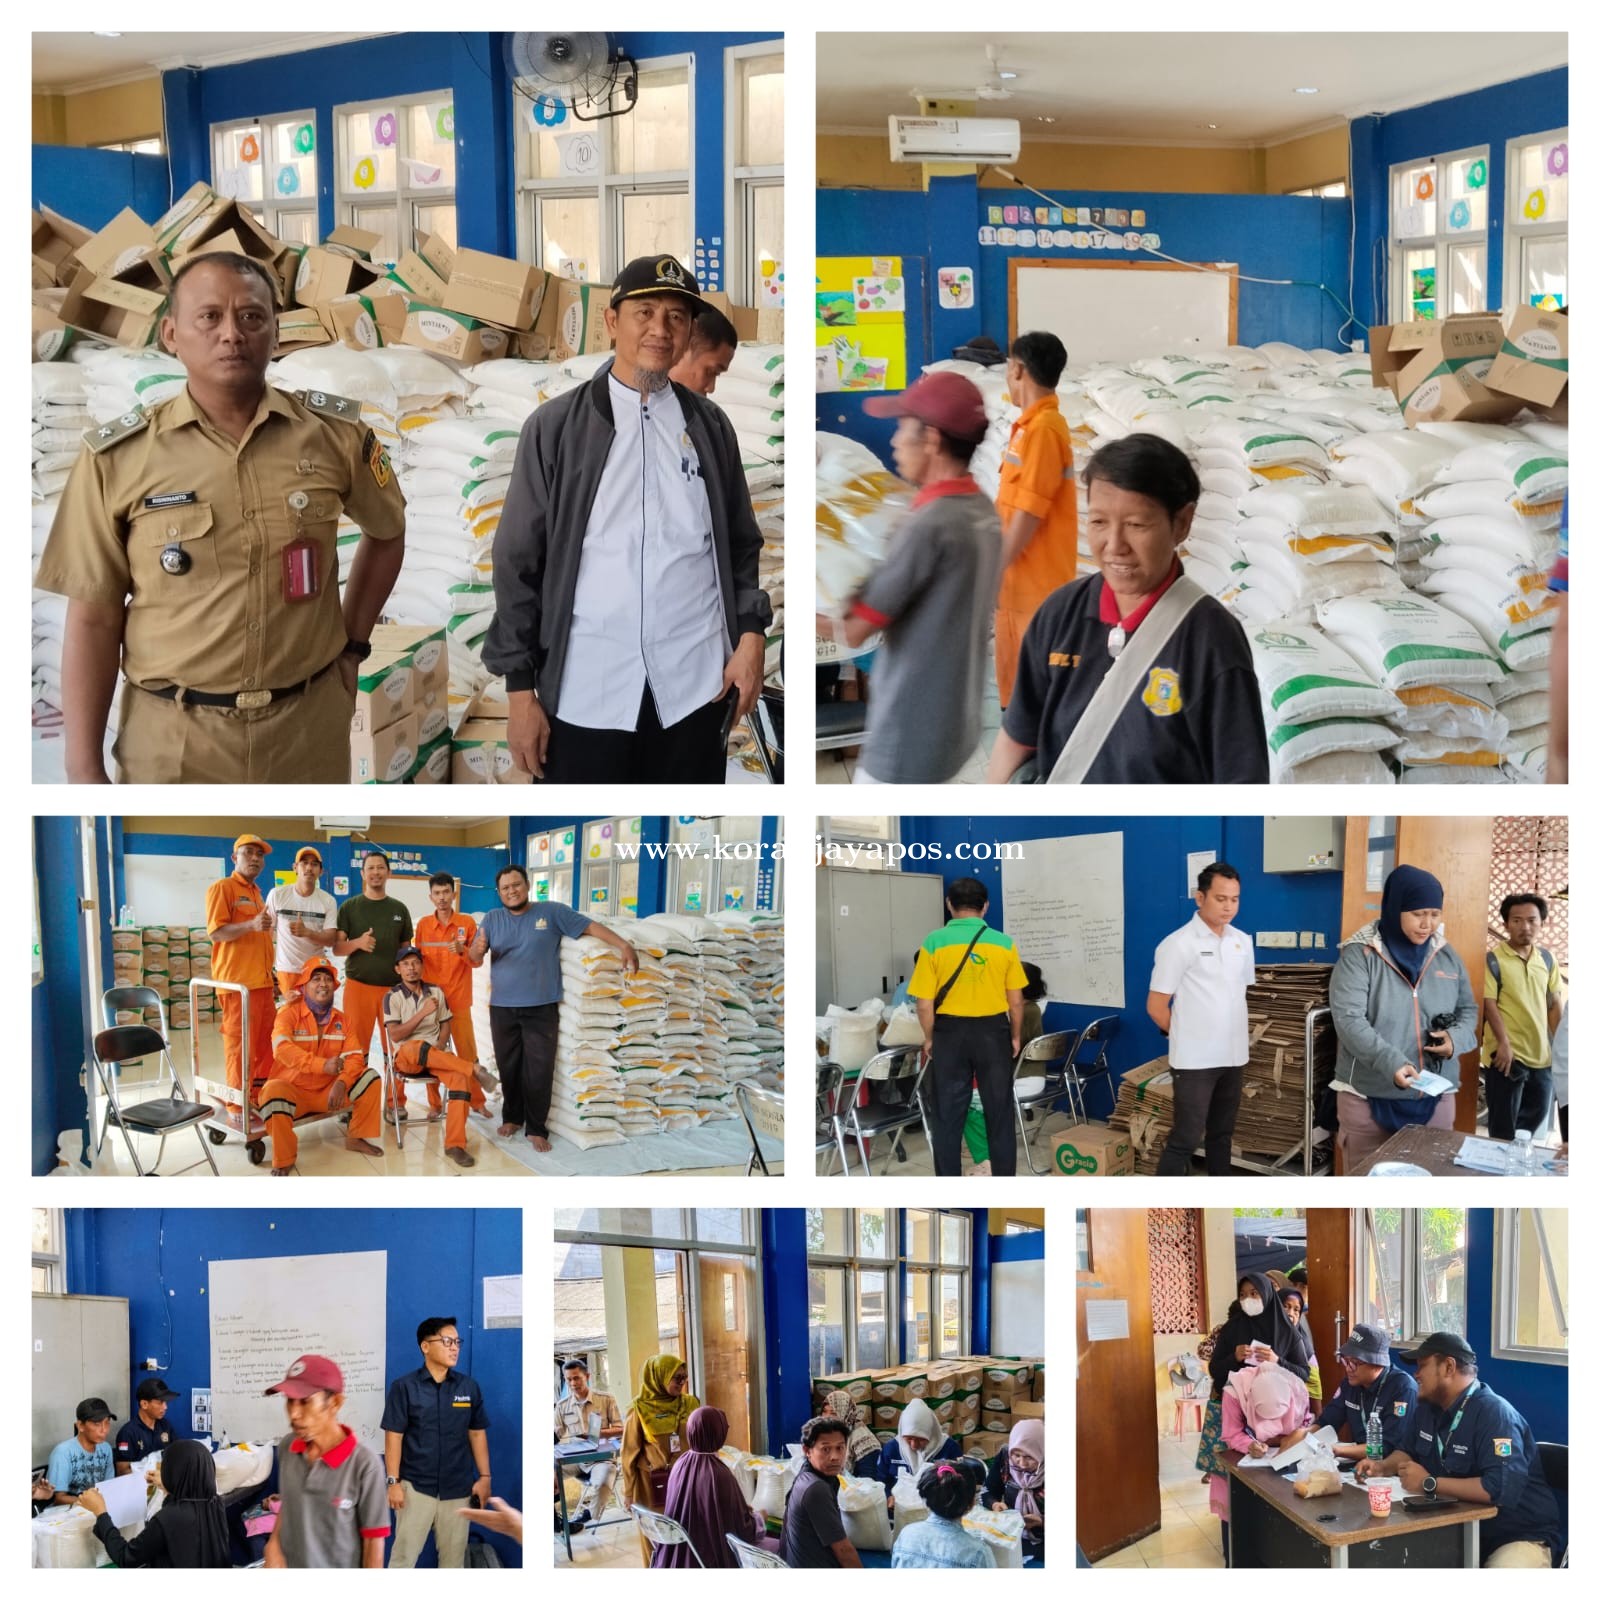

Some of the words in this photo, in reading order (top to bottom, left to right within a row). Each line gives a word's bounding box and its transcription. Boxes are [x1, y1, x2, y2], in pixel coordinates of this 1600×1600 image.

[980, 230, 996, 242] 11
[1038, 231, 1051, 243] 14
[1091, 233, 1105, 246] 17
[1125, 235, 1139, 246] 19
[1143, 235, 1159, 247] 20
[1061, 1150, 1095, 1169] Gracia
